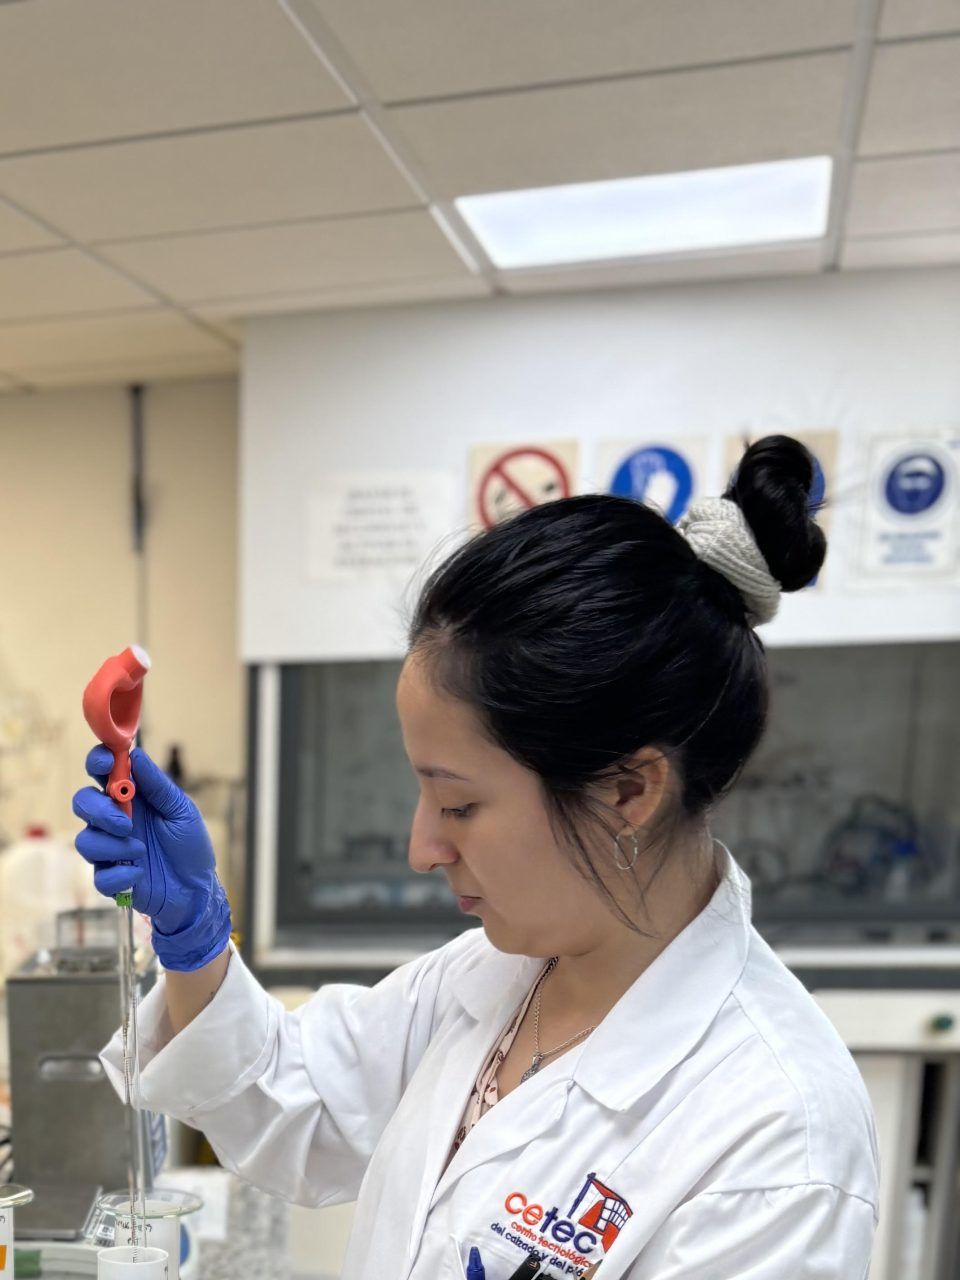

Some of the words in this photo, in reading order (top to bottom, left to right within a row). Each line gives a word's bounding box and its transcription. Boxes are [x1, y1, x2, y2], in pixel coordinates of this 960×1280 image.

[490, 1222, 506, 1237] del
[549, 1256, 567, 1270] del
[504, 1192, 597, 1254] cetec
[511, 1221, 538, 1242] centro
[538, 1236, 592, 1268] tecnológic
